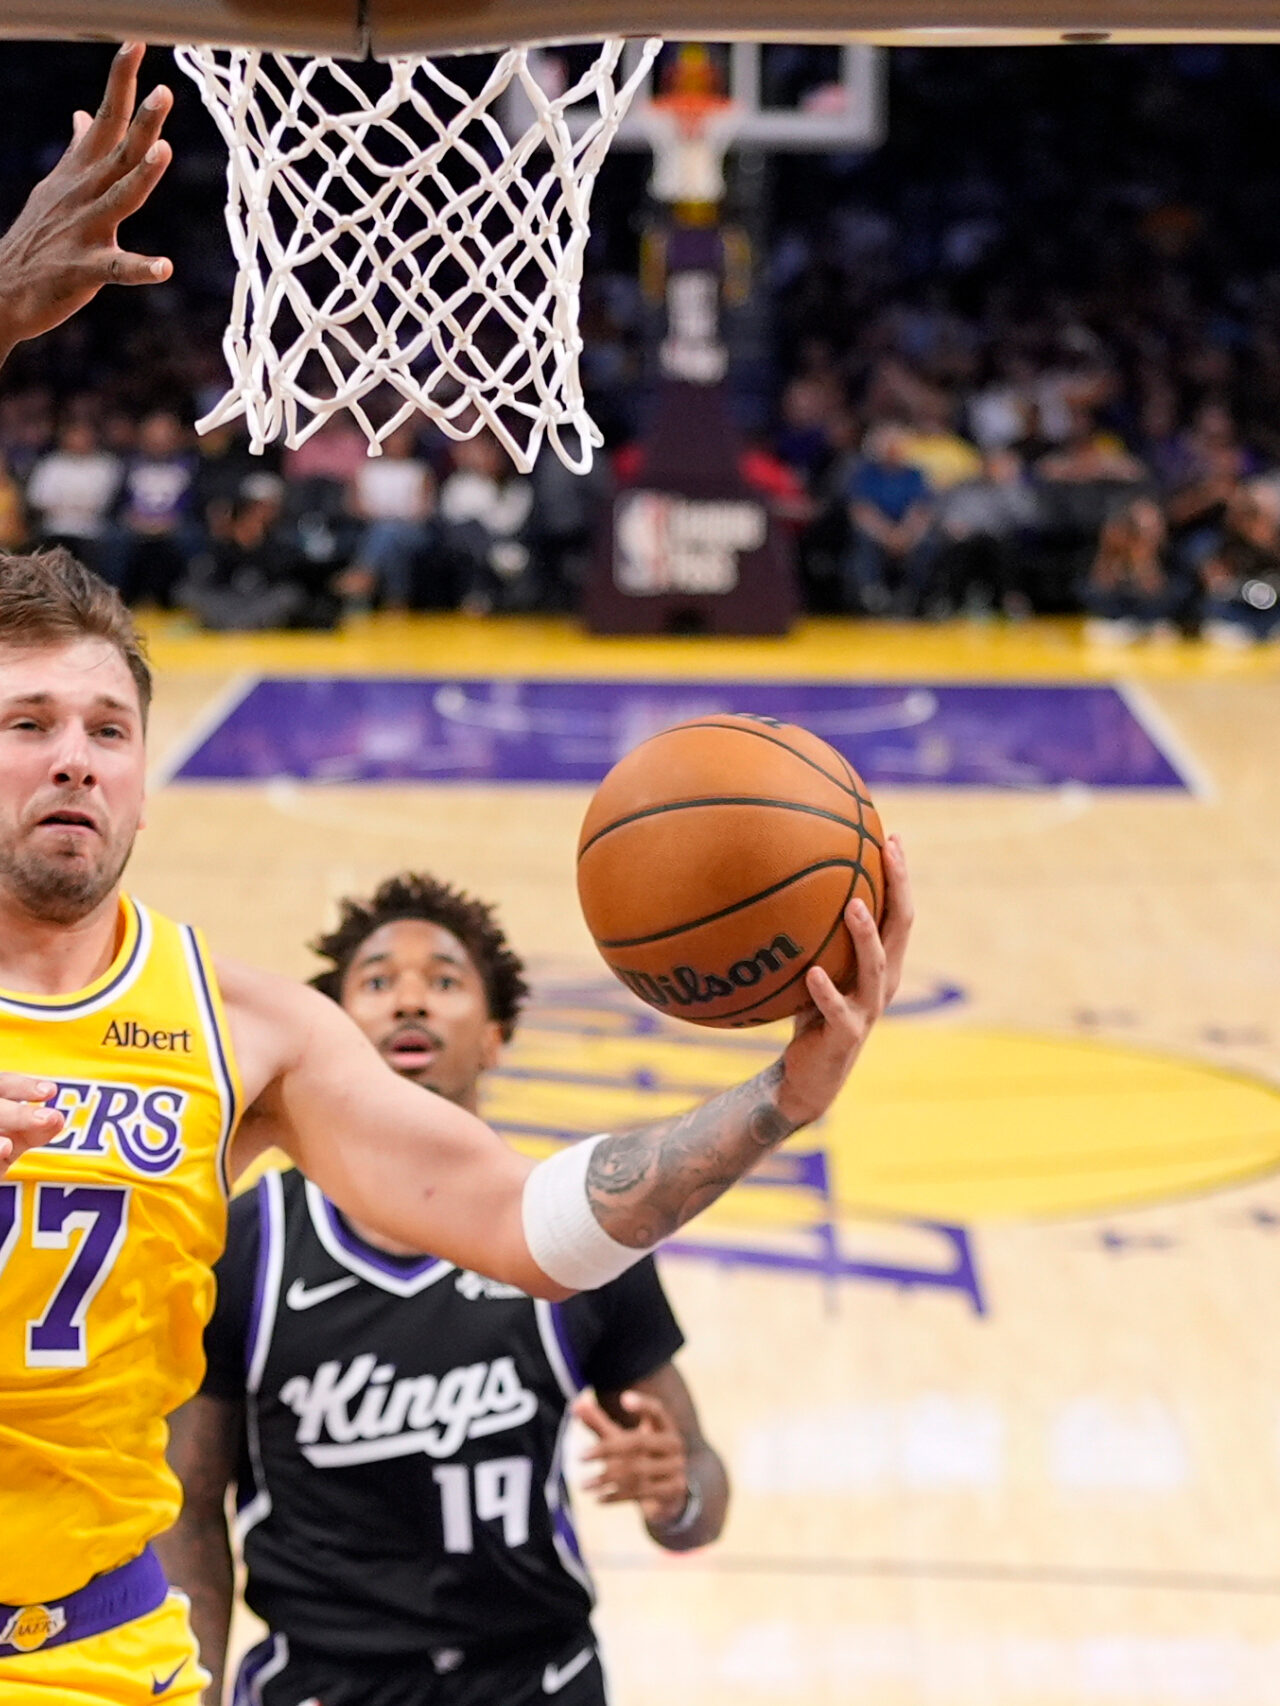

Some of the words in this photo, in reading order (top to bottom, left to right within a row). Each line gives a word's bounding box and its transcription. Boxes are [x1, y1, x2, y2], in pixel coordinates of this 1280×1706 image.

[614, 933, 804, 1006] Wilson
[101, 1019, 192, 1053] Albert
[279, 1353, 538, 1468] Kings
[432, 1456, 532, 1553] 19
